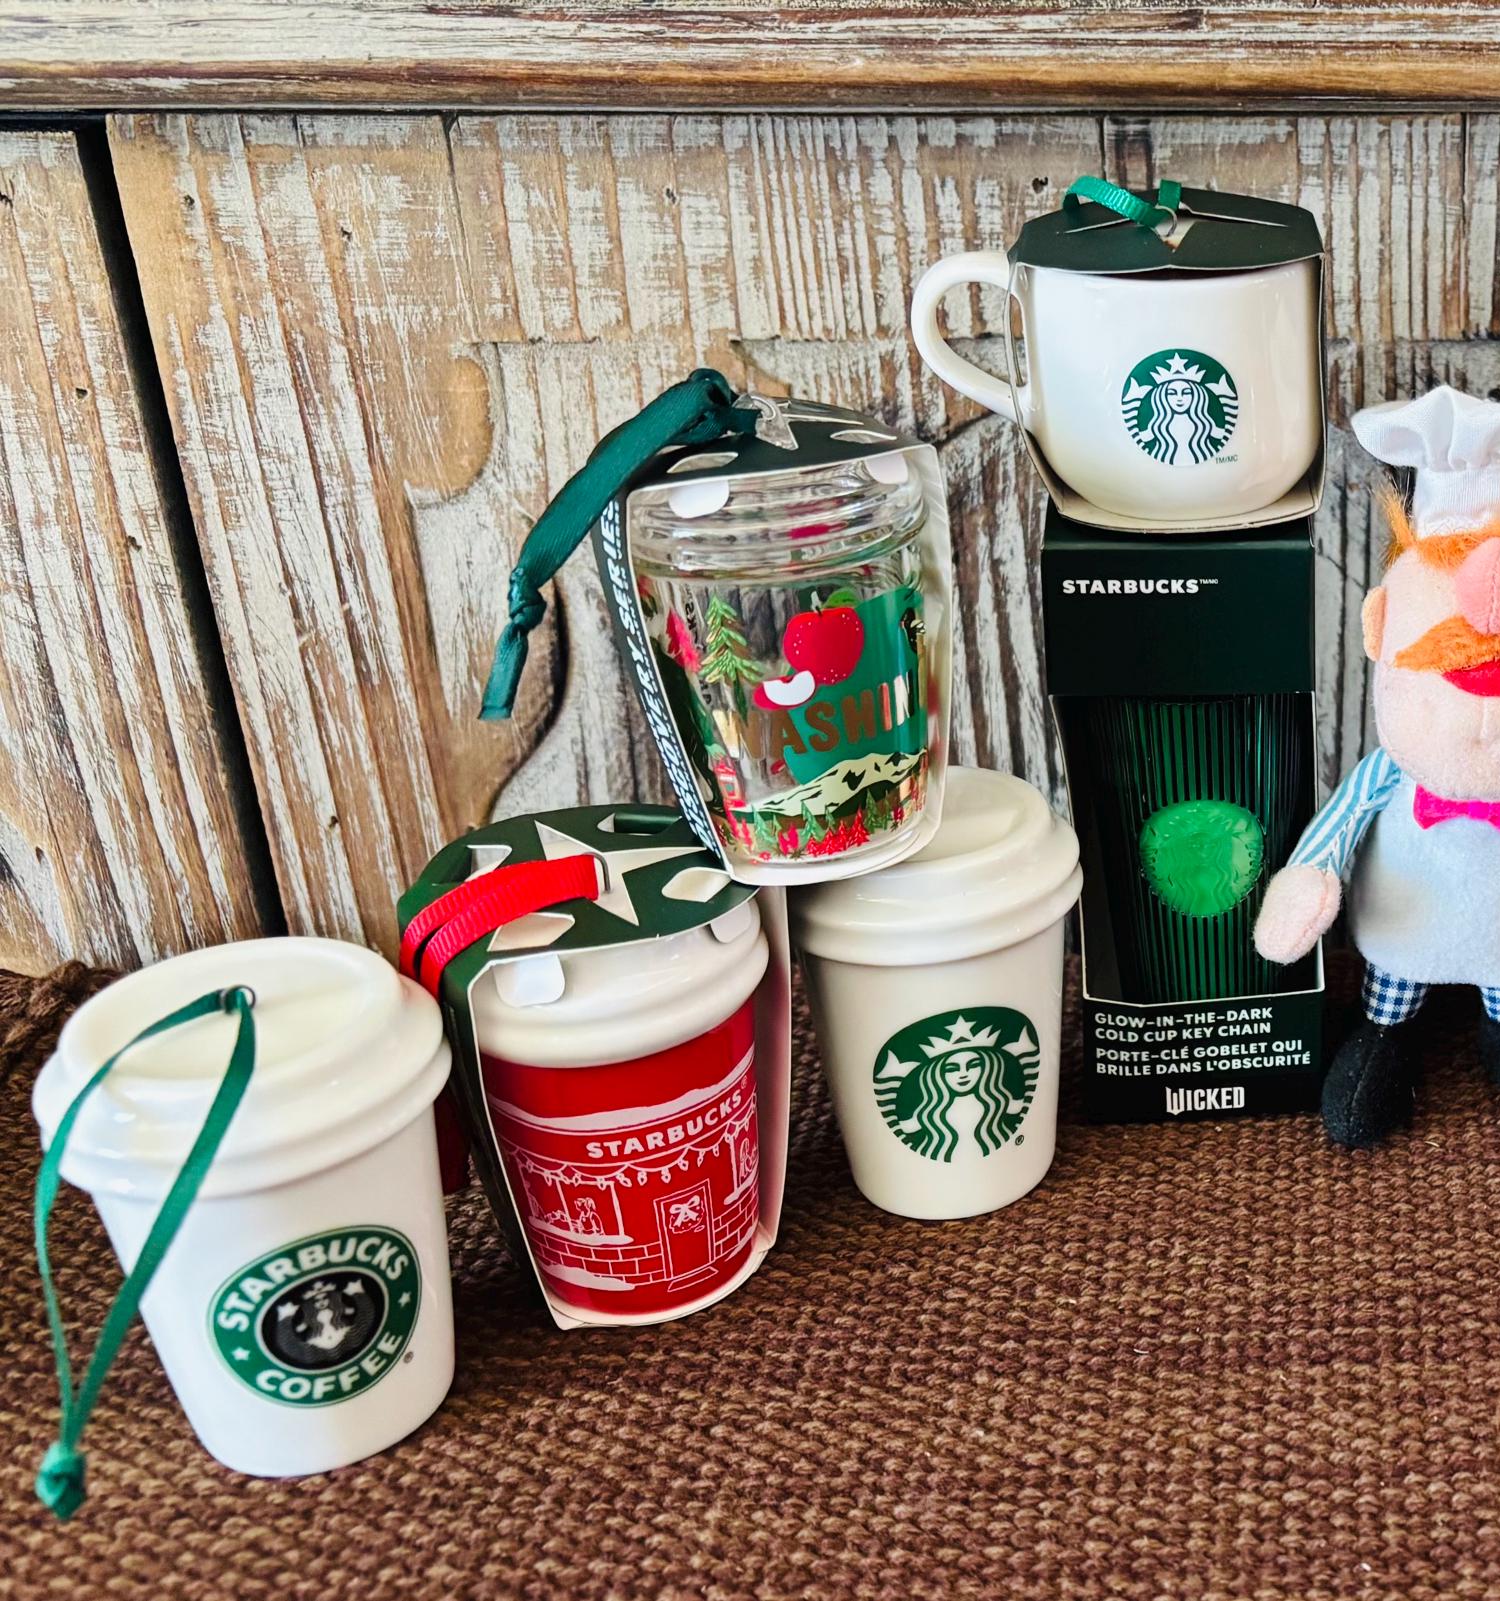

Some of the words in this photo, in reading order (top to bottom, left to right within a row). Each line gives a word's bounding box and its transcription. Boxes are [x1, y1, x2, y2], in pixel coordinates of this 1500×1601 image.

[1062, 579, 1199, 594] STARBUCKS
[627, 635, 715, 854] DISCOVERY
[1095, 1006, 1273, 1029] GLOW-IN-THE-DARK
[1095, 1027, 1139, 1043] COLD
[1143, 1030, 1178, 1043] CUP
[1182, 1027, 1214, 1040] KEY
[1218, 1022, 1271, 1037] CHAIN
[1096, 1046, 1189, 1062] PORTE-CLÉ
[1193, 1042, 1267, 1058] GOBELET
[1272, 1039, 1302, 1053] QUI
[1096, 1062, 1151, 1077] BRILLE
[1156, 1061, 1201, 1075] DANS
[1206, 1051, 1311, 1072] L'OBSCURITÉ
[1165, 1086, 1245, 1116] WICKED
[586, 1089, 742, 1158] STARBUCKS
[217, 1236, 409, 1332] STARBUCKS
[256, 1331, 403, 1399] COFFEE
